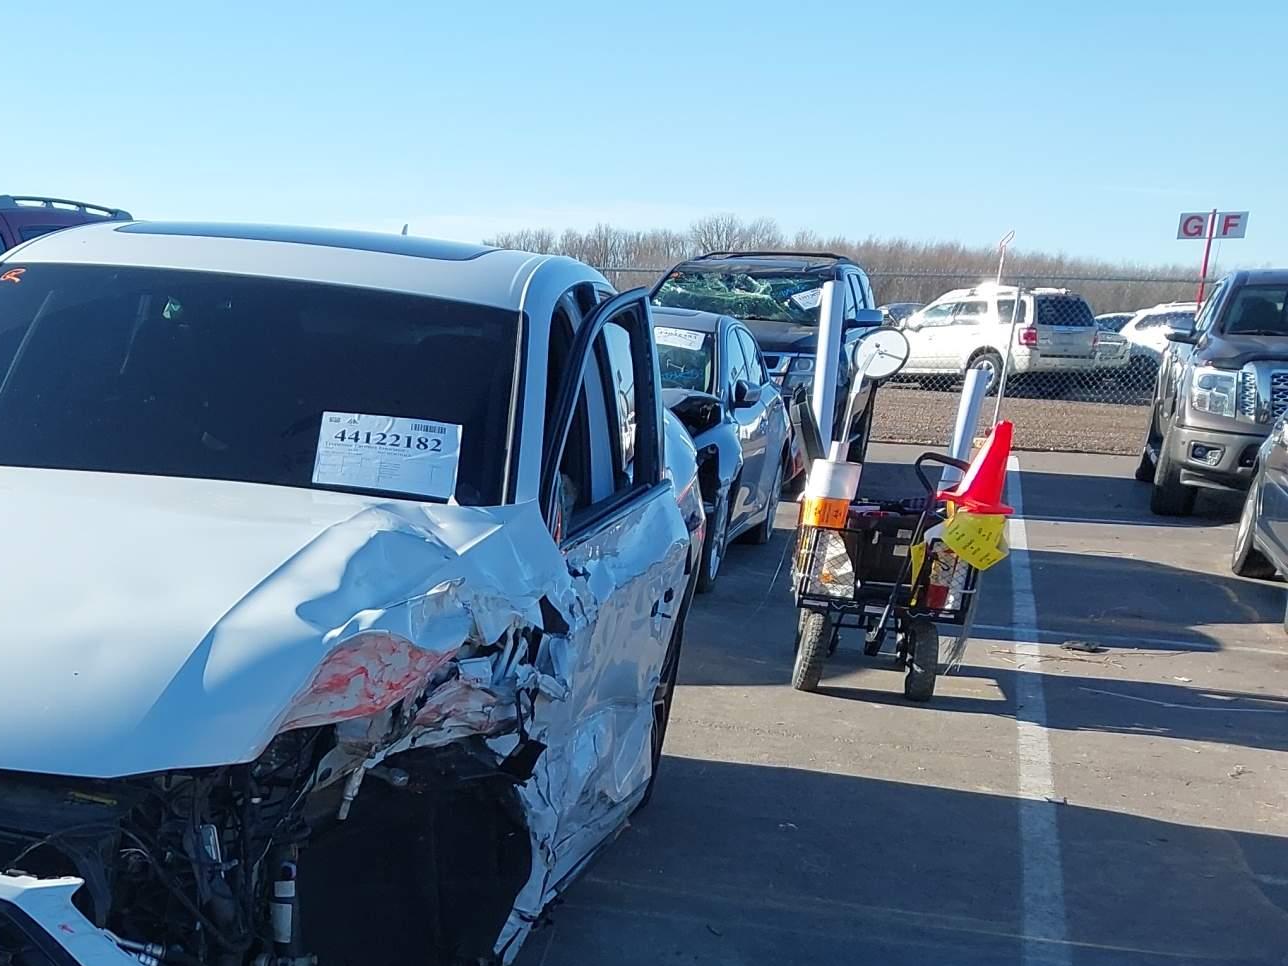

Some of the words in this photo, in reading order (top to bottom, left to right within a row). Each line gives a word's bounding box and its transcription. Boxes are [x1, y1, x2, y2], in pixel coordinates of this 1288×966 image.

[1182, 215, 1204, 237] G
[1222, 215, 1241, 236] F
[334, 428, 443, 453] 44122182
